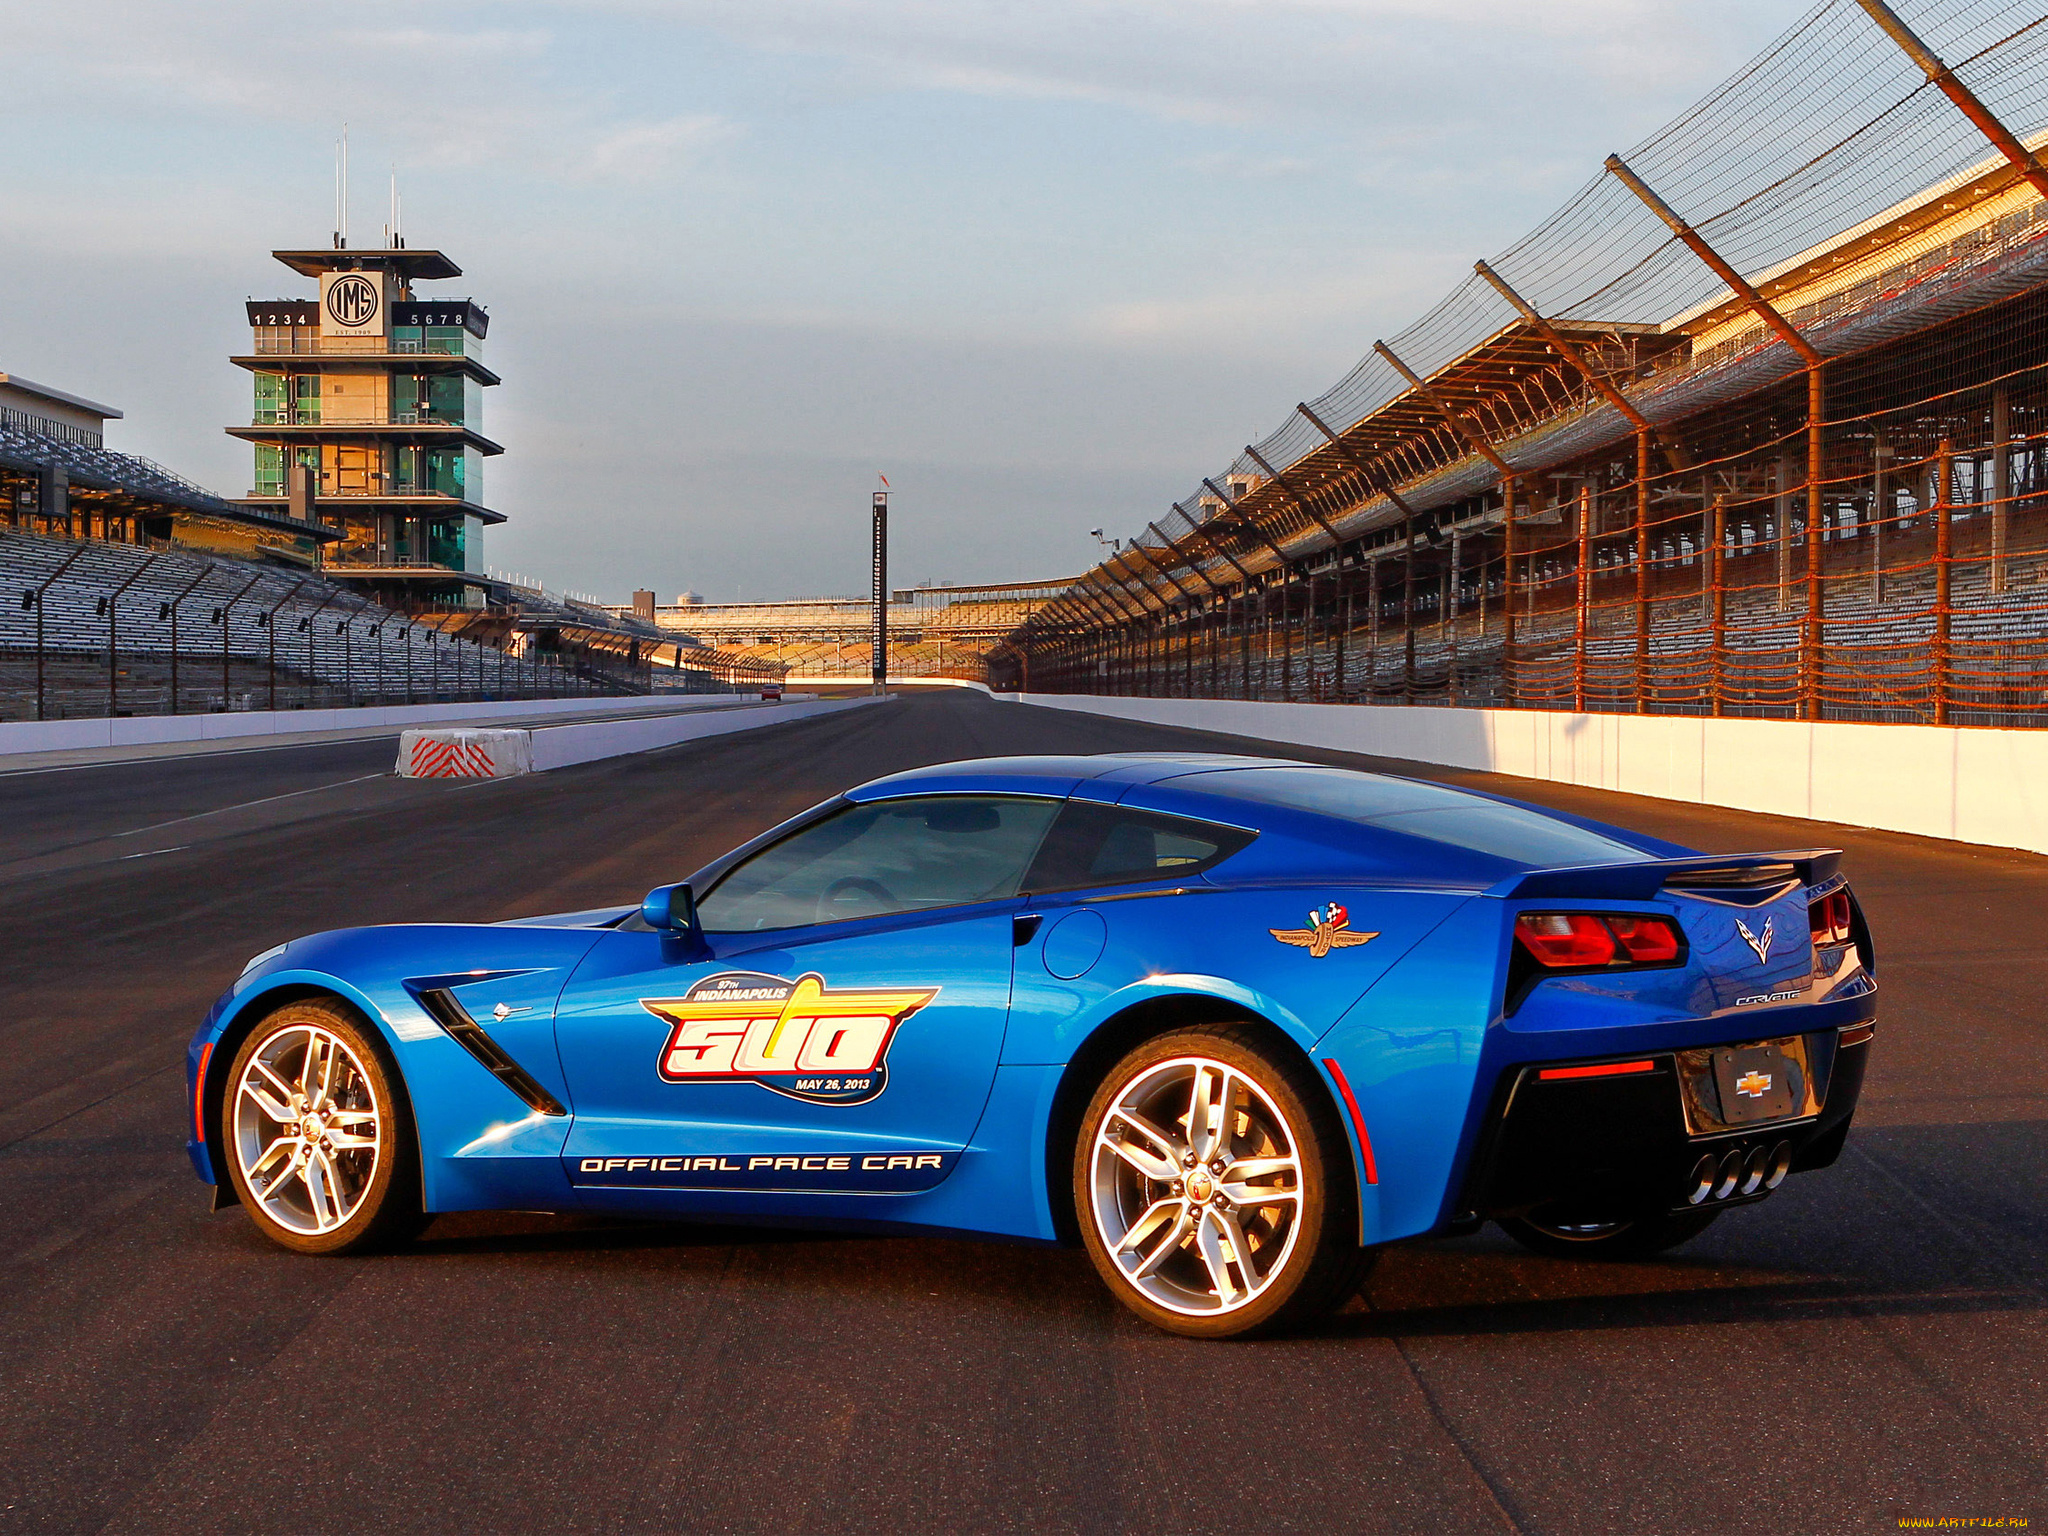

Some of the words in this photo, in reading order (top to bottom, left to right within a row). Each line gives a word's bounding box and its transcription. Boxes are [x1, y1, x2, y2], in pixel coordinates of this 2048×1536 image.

[336, 282, 371, 319] IMS
[254, 314, 260, 325] 1
[269, 314, 277, 325] 2
[283, 314, 291, 325] 3
[298, 314, 306, 325] 4
[411, 314, 418, 325] 5
[425, 314, 433, 325] 6
[440, 314, 448, 325] 7
[455, 314, 463, 325] 8
[717, 980, 740, 990] 97TH
[693, 987, 788, 1001] INDIANAPOLIS
[796, 1079, 823, 1090] MAY
[824, 1079, 841, 1091] 26,
[843, 1079, 870, 1090] 2013
[579, 1158, 741, 1172] OFFICIAL
[748, 1157, 850, 1170] PACE
[861, 1155, 942, 1170] CAR
